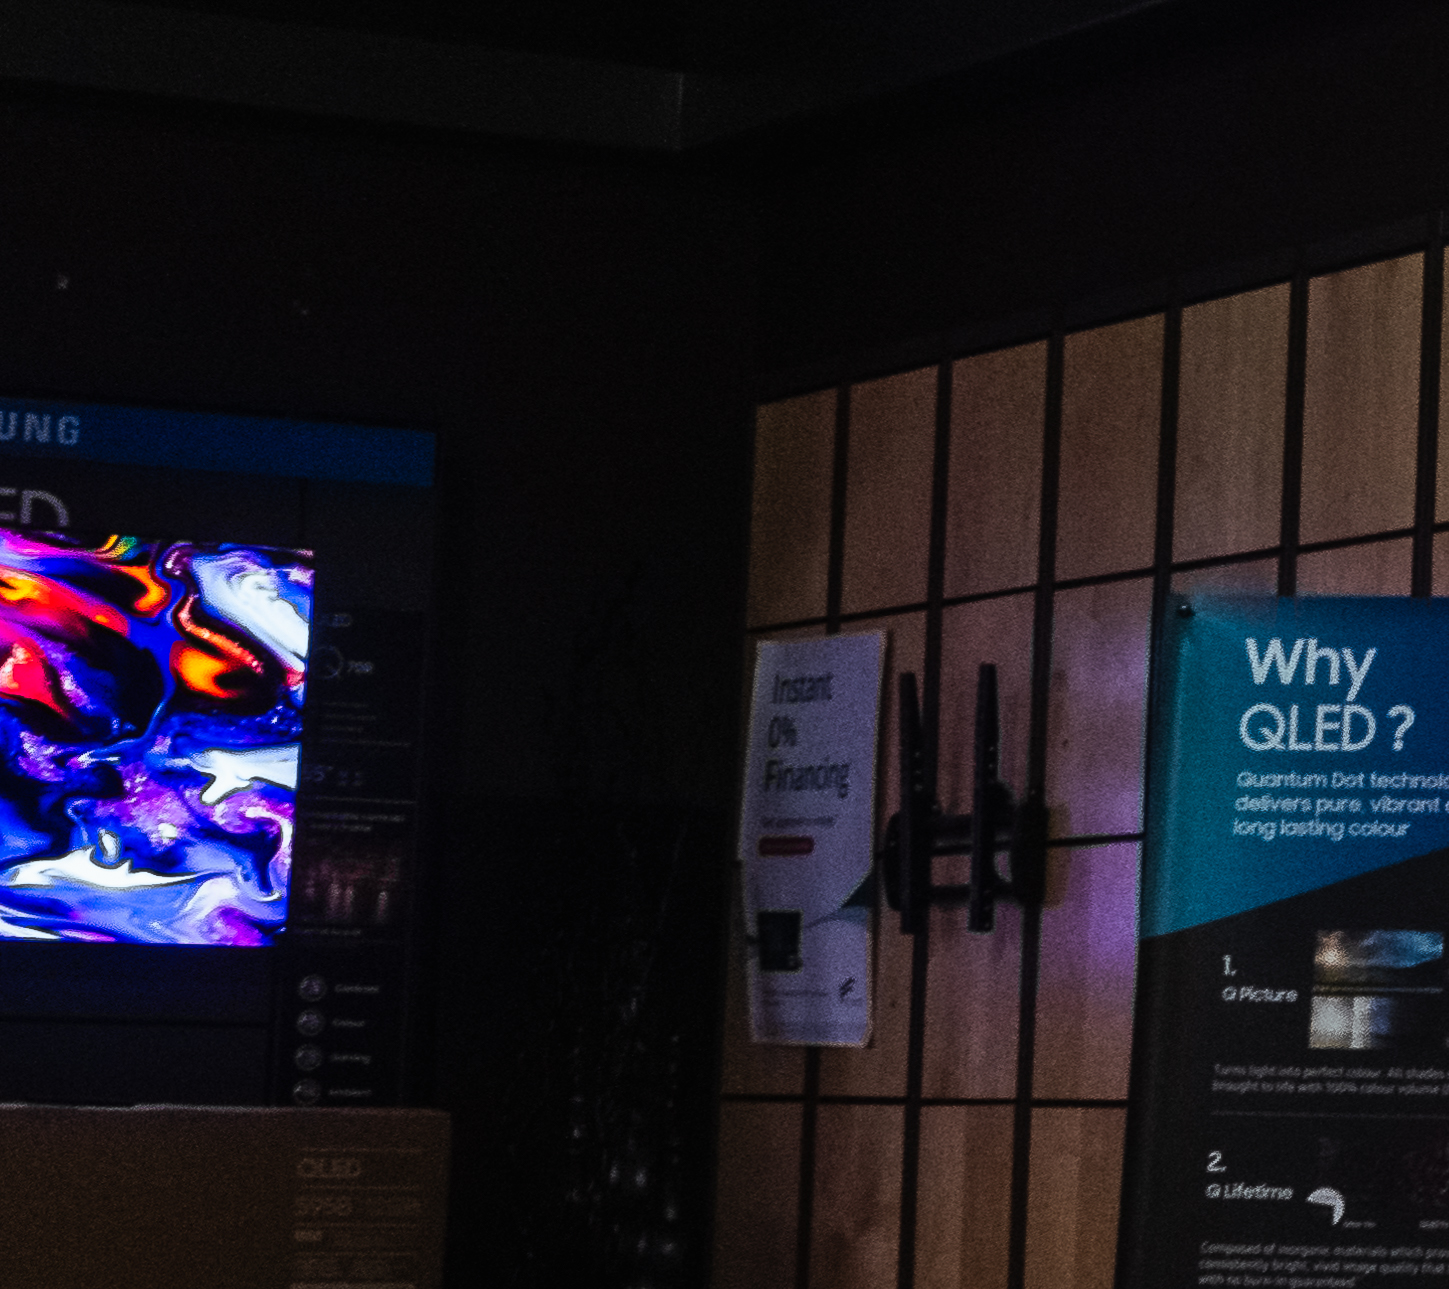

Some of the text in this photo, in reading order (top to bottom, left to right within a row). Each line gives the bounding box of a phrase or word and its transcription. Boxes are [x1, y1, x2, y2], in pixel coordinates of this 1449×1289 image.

[1245, 636, 1378, 701] Why
[773, 673, 833, 704] Instant
[768, 716, 797, 748] 0%
[1239, 703, 1416, 752] QLED ?
[764, 758, 850, 799] Financing
[1236, 770, 1328, 788] Quantum
[1331, 772, 1365, 789] Dot
[1234, 794, 1312, 812] delivers
[1369, 796, 1440, 813] vibrant
[1233, 818, 1411, 842] long lasting colour
[1239, 986, 1298, 1004] Picture
[1222, 1182, 1294, 1201] Lifetime
